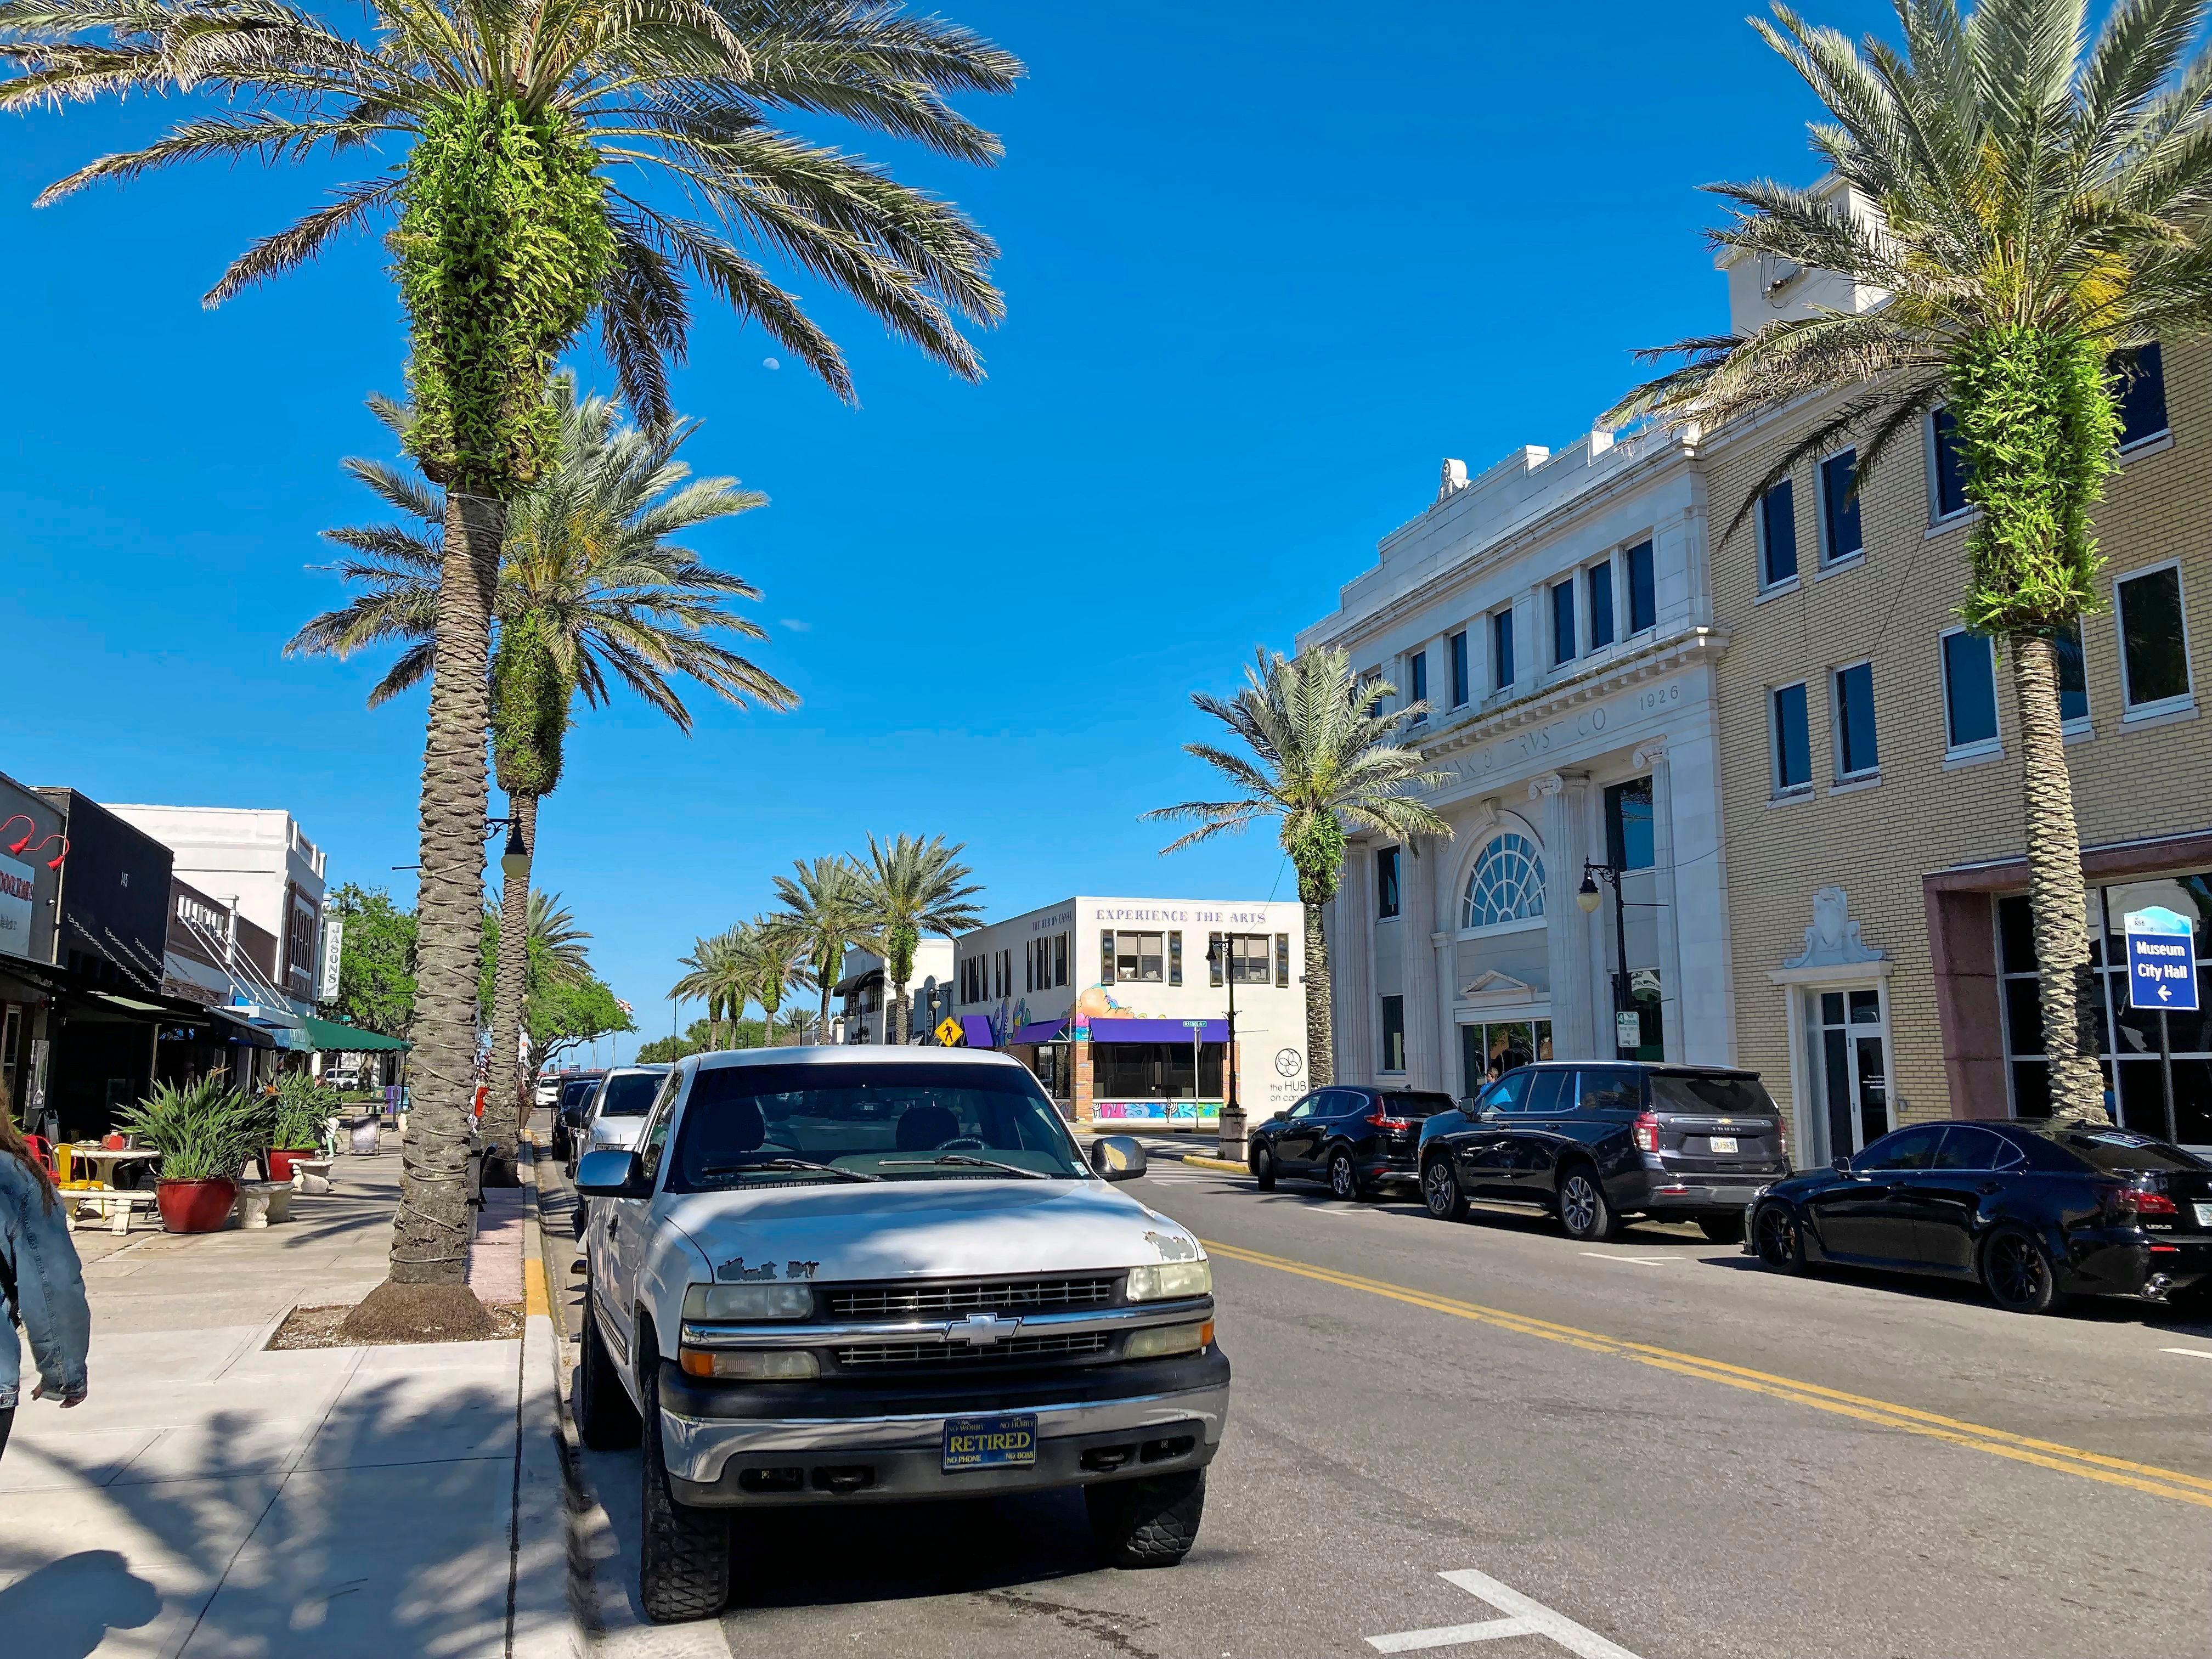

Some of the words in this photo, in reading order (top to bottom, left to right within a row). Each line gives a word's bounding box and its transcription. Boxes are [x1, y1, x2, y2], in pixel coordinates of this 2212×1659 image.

[1639, 685, 1678, 711] 1926
[1577, 707, 1606, 736] CO
[1032, 921, 1040, 932] THE
[1041, 918, 1051, 929] HUB
[1051, 916, 1057, 927] ON
[1058, 911, 1073, 924] CANAL
[1096, 909, 1188, 921] EXPERIENCE
[1195, 911, 1223, 922] THE
[1230, 912, 1266, 923] ARTS
[328, 924, 340, 983] JASONS
[2136, 941, 2186, 956] Museum
[2137, 963, 2163, 981] City
[2164, 964, 2188, 979] Hall
[1618, 1014, 1623, 1023] 4
[1285, 1081, 1306, 1091] HUB
[950, 1431, 1030, 1453] RETIRED
[958, 1454, 981, 1463] PHONE
